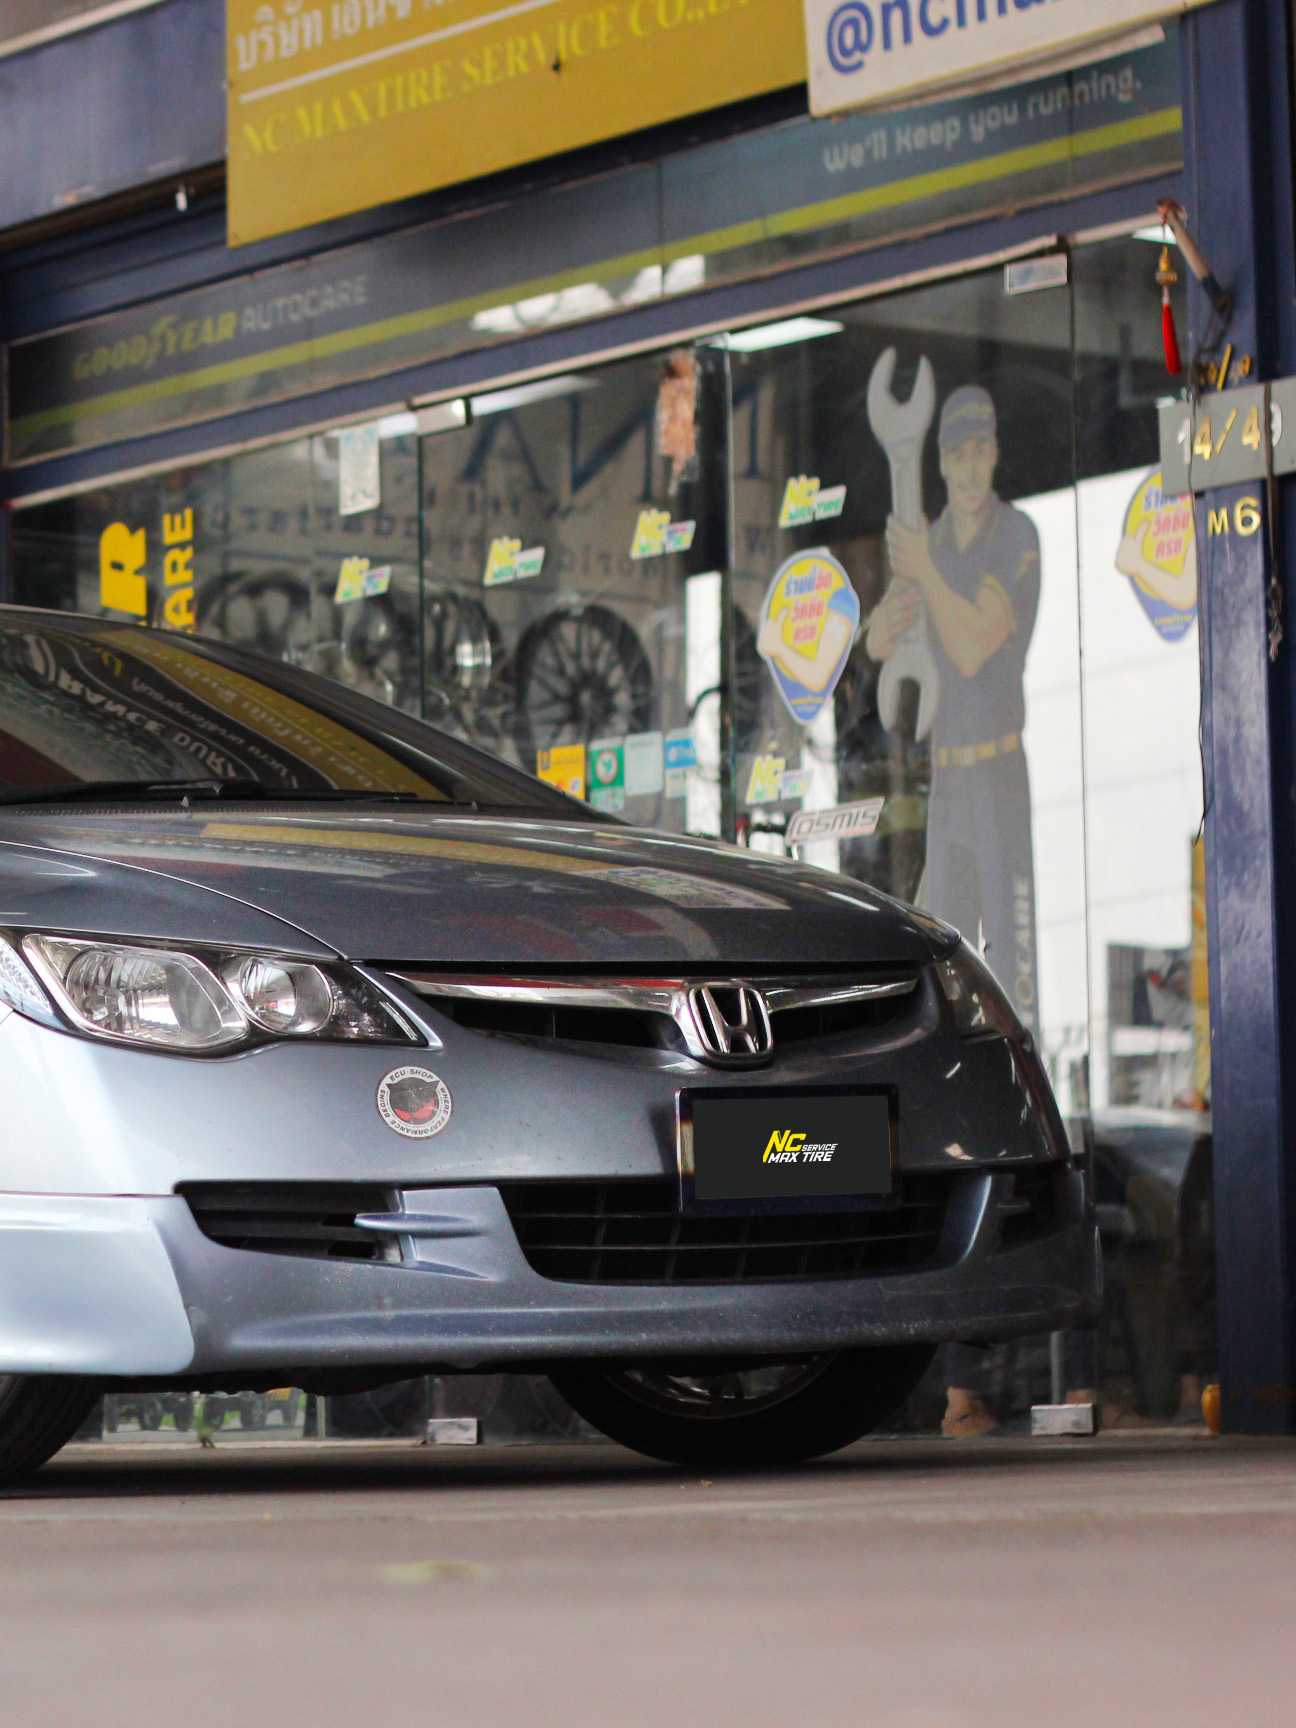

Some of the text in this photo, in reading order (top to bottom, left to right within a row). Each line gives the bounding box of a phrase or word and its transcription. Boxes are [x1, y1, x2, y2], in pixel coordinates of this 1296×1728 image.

[969, 102, 1020, 144] you
[72, 274, 368, 381] GOODYEAR AUTOCARE
[379, 1089, 391, 1118] BEGINS
